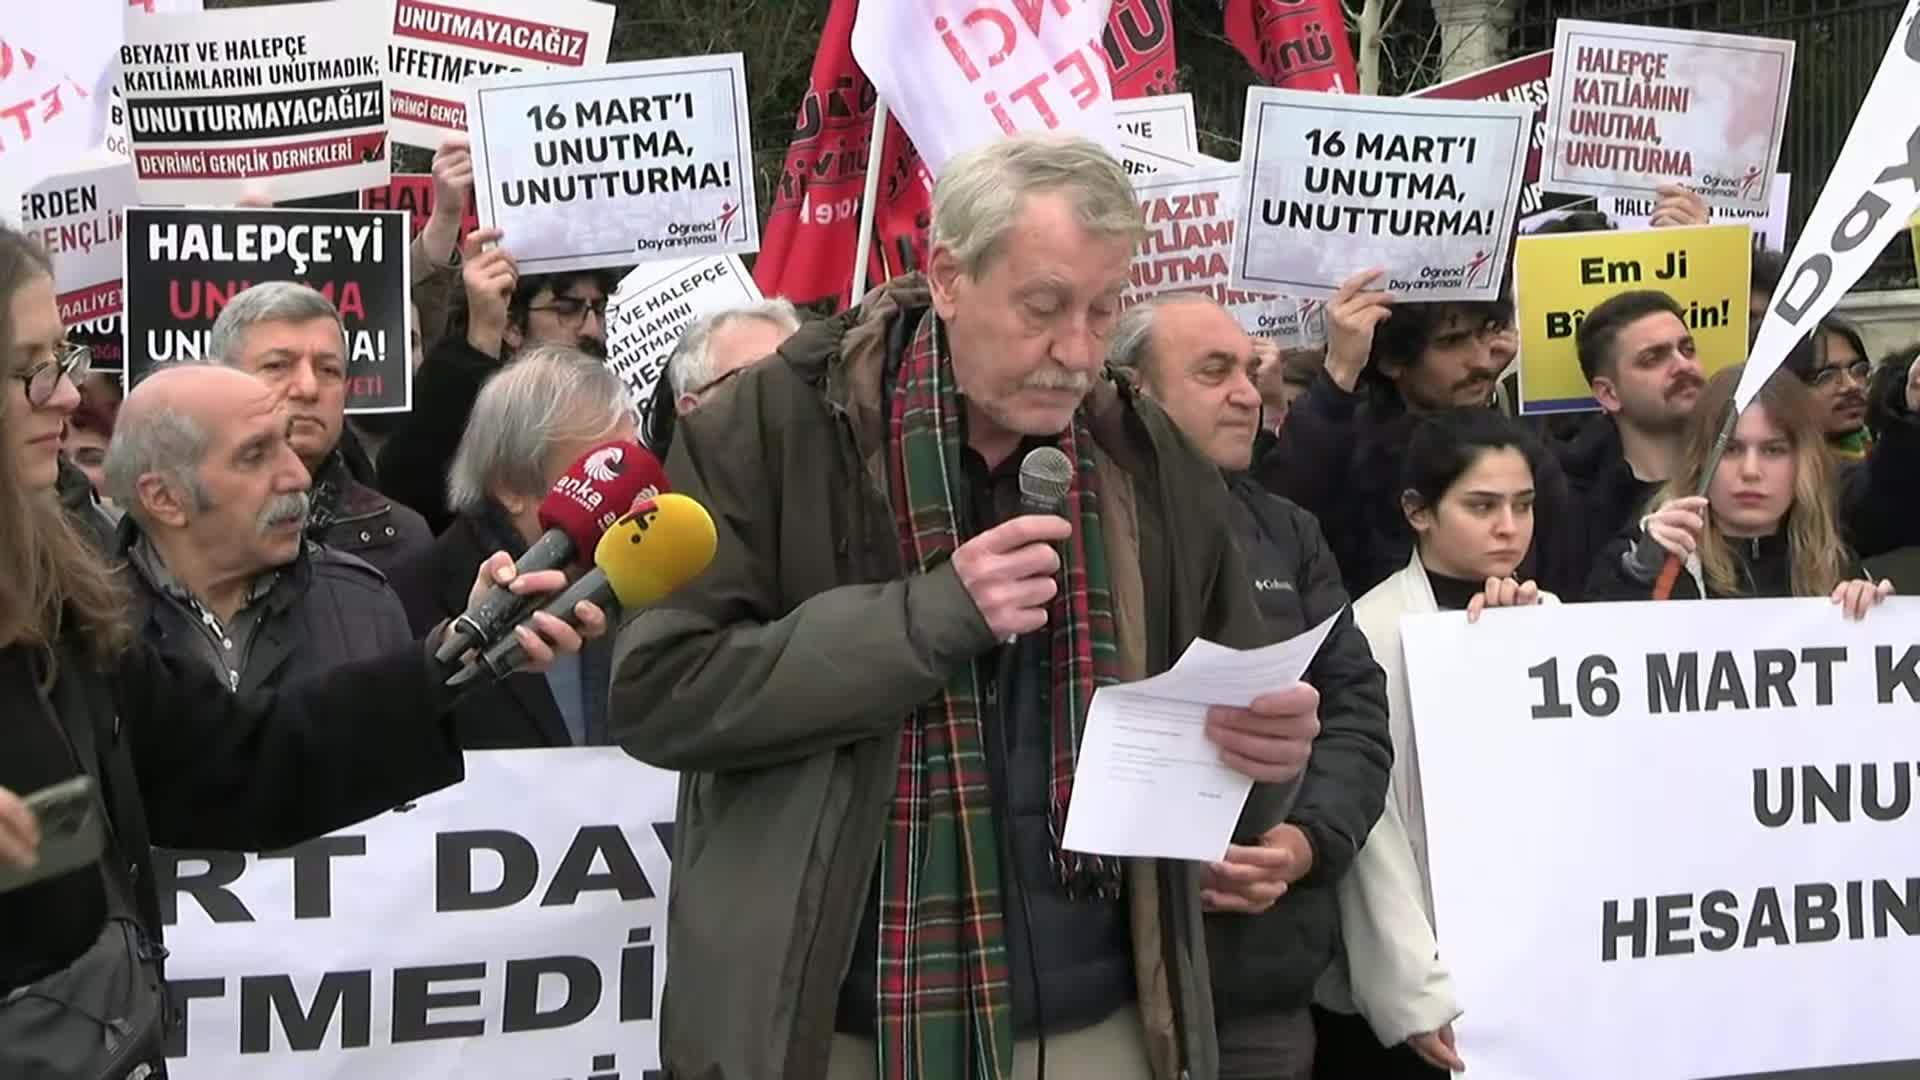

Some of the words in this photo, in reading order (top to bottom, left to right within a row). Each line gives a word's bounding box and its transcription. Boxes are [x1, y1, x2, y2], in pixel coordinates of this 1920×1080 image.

[121, 43, 190, 65] BEYAZIT
[196, 42, 218, 62] VE
[226, 35, 307, 62] HALEPÇE
[399, 5, 586, 59] UNUTMAYACAĞIZ
[124, 66, 262, 92] KATLİAMLARINI
[268, 55, 380, 85] UNUTMADIK;
[1577, 46, 1668, 81] HALEPÇE
[132, 88, 381, 133] UNUTTURMAYACAĞIZ!
[527, 104, 567, 132] 16
[575, 93, 693, 128] MART'I
[1573, 78, 1689, 113] KATLİAMINI
[1569, 110, 1661, 145] UNUTMA,
[140, 152, 208, 174] DEVRİMCİ
[209, 149, 269, 178] GENÇLİK
[273, 139, 353, 169] DERNEKLERİ
[534, 130, 693, 168] UNUTMA,
[1305, 129, 1345, 156] 16
[1356, 132, 1476, 164] MART'I
[1566, 141, 1692, 176] UNUTTURMA
[502, 162, 731, 207] UNUTTURMA!
[1305, 167, 1465, 202] UNUTMA,
[1262, 200, 1494, 236] UNUTTURMA!
[149, 218, 384, 274] HALEPÇE'Yİ
[1581, 257, 1640, 284] Em
[1656, 251, 1687, 280] Ji
[620, 305, 645, 326] VE
[646, 262, 728, 312] HALEPÇE
[557, 475, 603, 508] anka
[1528, 654, 1621, 720] 16
[1646, 646, 1848, 714] MART
[1753, 761, 1920, 828] UNU
